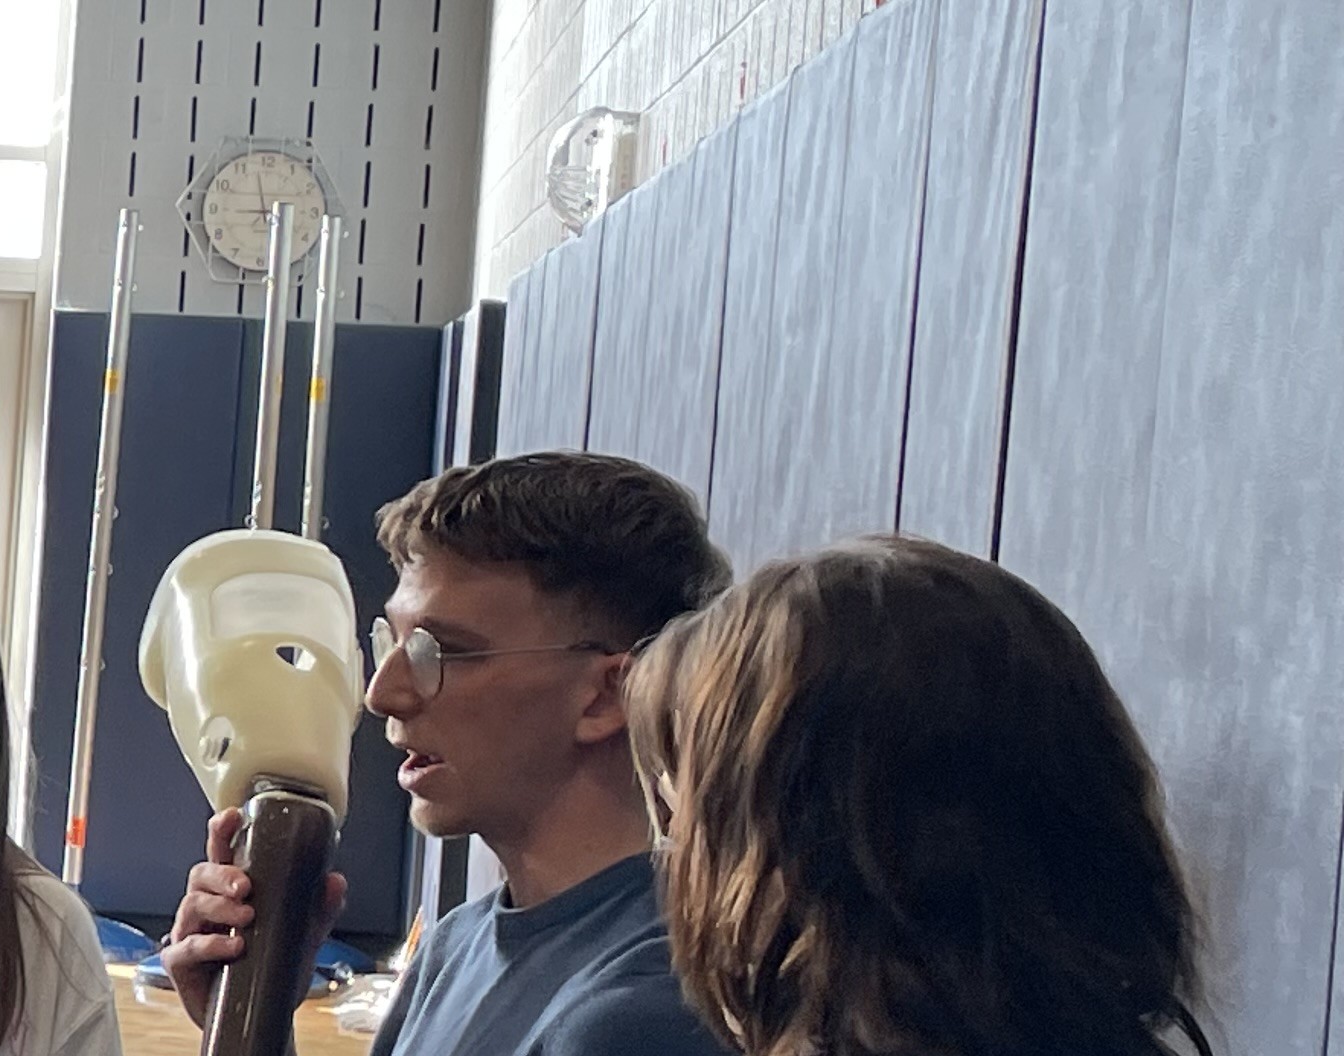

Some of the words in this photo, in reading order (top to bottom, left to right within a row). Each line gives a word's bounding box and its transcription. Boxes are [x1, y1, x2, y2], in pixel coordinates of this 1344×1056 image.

[234, 162, 247, 174] 11
[262, 156, 276, 168] 12
[215, 179, 230, 191] 10
[306, 182, 315, 195] 2
[208, 203, 218, 215] 9
[310, 207, 319, 219] 3
[214, 228, 223, 240] 8
[301, 232, 309, 243] 4
[231, 248, 240, 257] 7
[256, 257, 265, 267] 6
